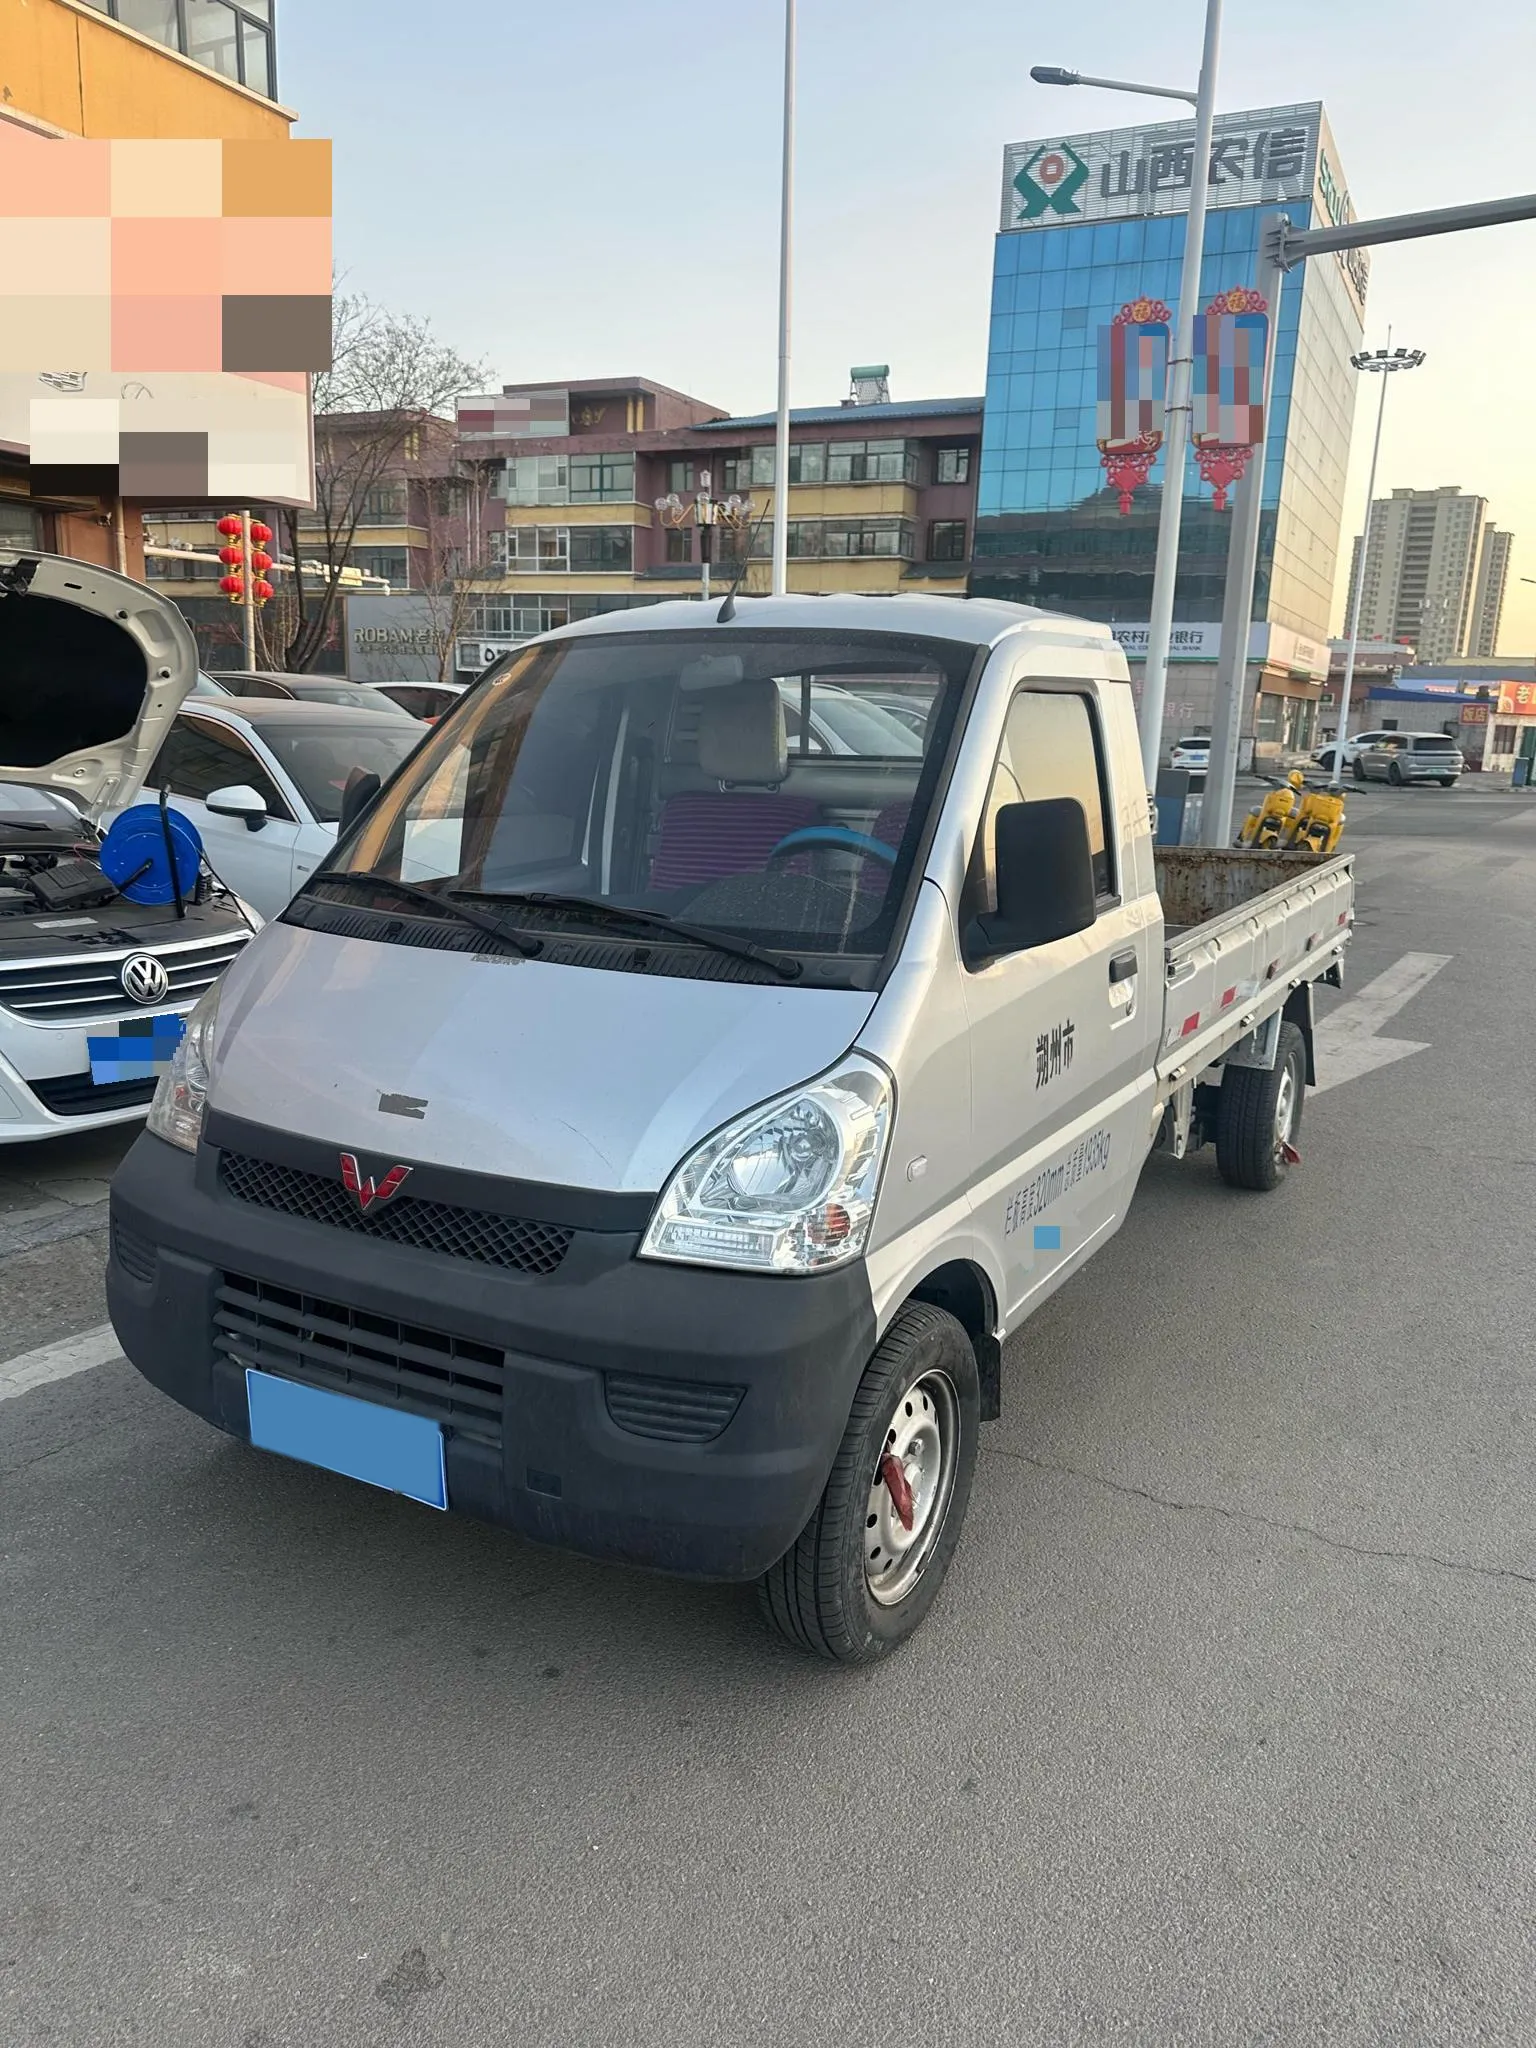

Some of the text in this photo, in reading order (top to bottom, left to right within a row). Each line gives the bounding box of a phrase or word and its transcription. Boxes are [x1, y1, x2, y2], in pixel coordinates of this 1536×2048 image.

[1101, 127, 1309, 198] 山西农信
[354, 627, 413, 643] ROBAM
[1035, 1018, 1075, 1091] 朔州市
